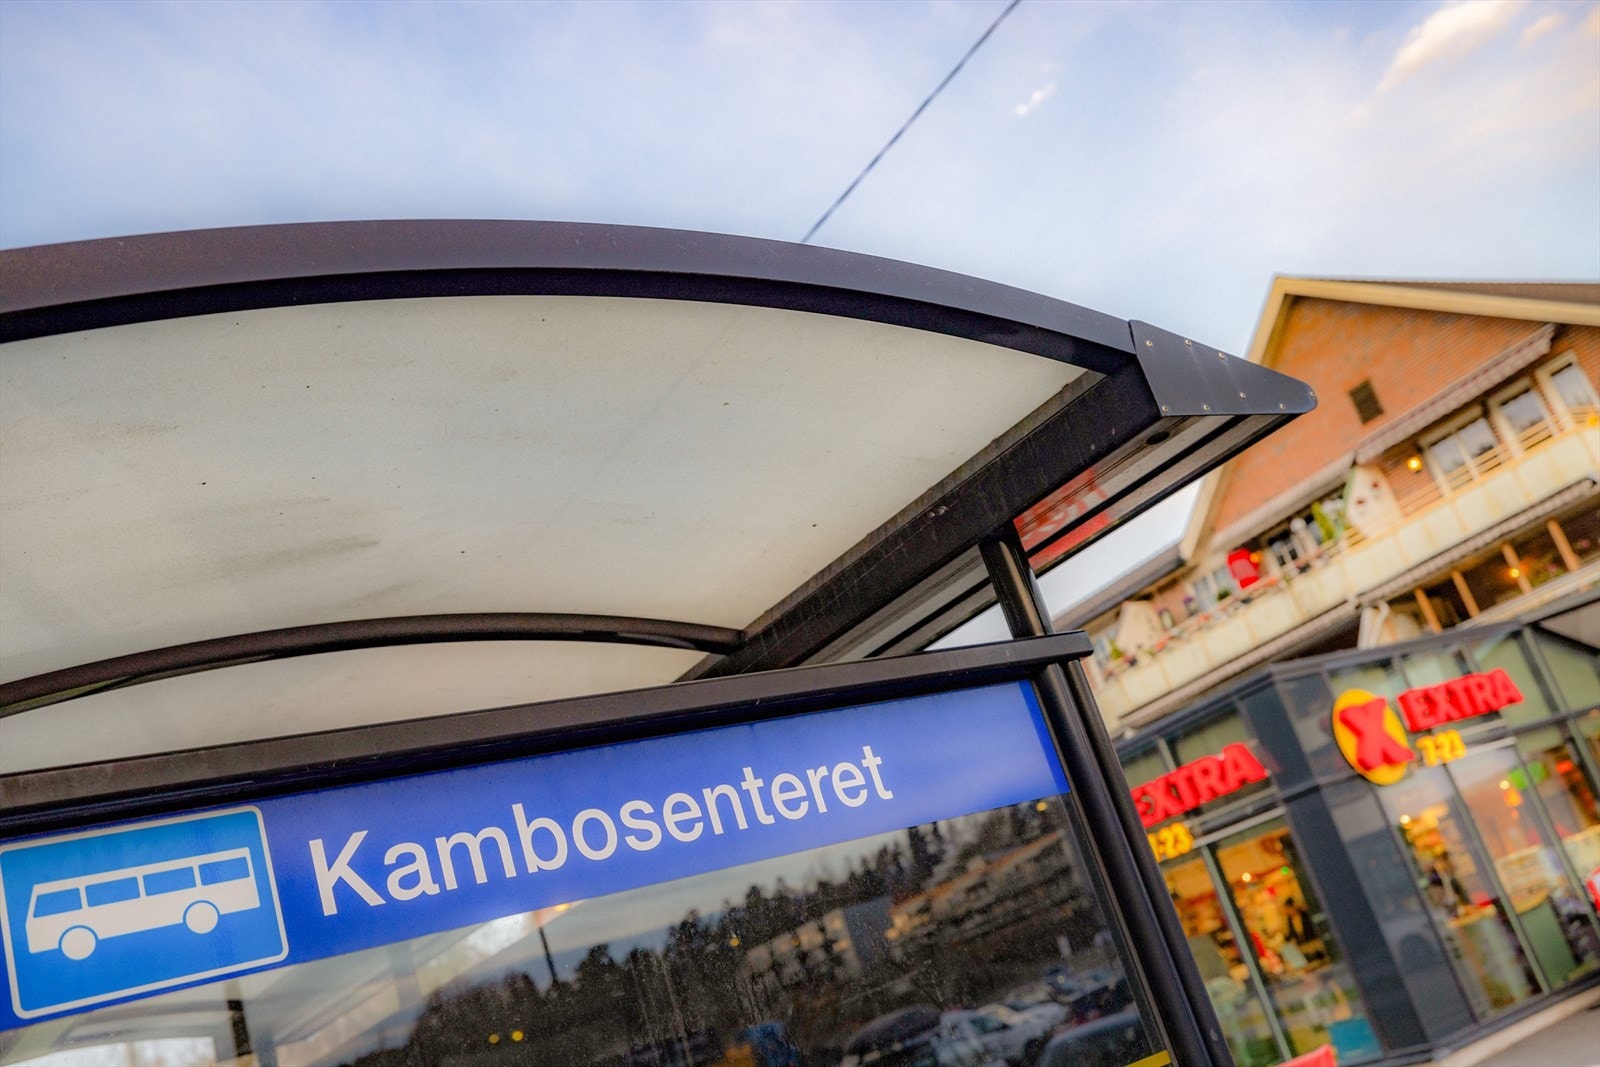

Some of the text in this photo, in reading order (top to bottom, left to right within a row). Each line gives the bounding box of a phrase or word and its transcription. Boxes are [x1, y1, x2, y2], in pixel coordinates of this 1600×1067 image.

[1339, 696, 1415, 772] X
[1398, 668, 1524, 733] EXTRA
[309, 746, 893, 917] Kambosenteret
